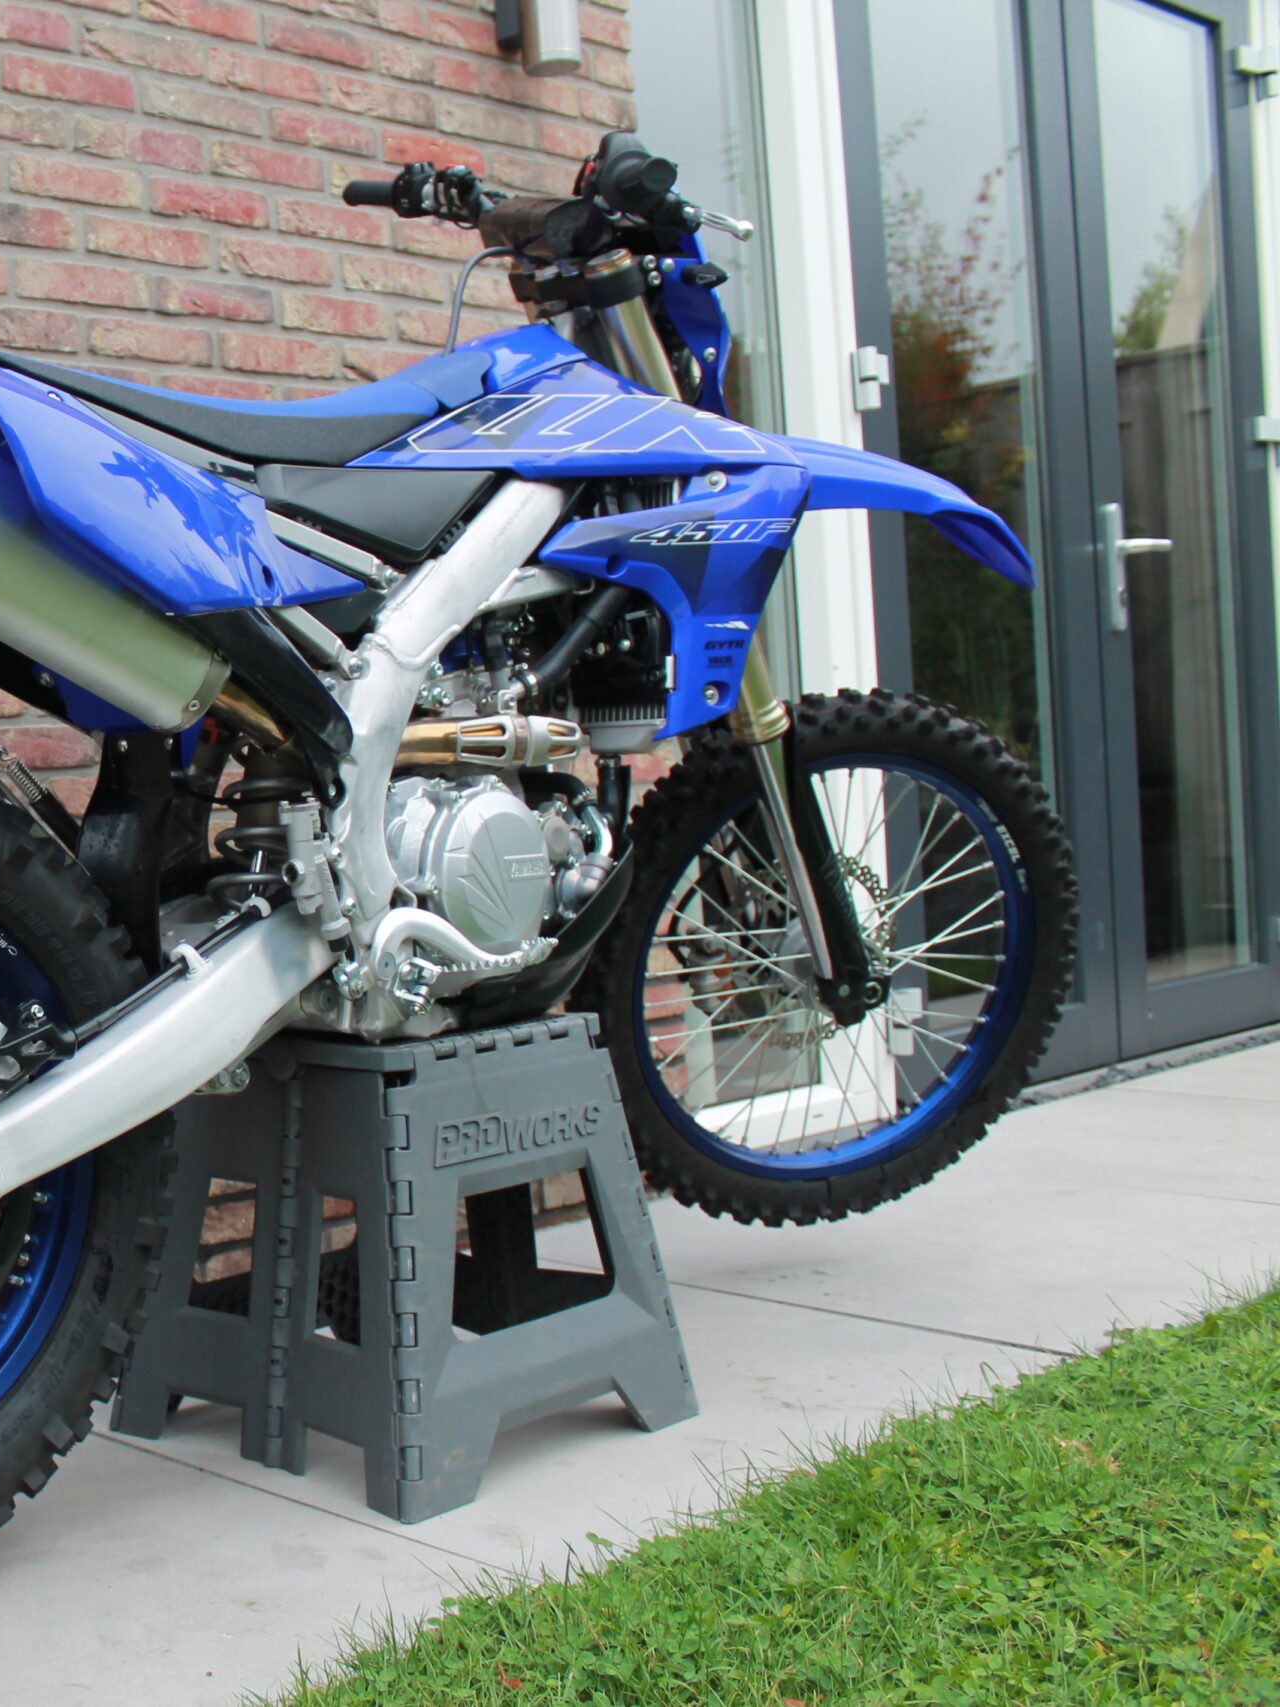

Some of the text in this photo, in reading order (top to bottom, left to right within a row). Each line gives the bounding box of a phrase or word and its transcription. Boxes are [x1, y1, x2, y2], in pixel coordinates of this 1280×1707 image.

[630, 518, 796, 545] 450F
[704, 639, 746, 650] GYTR
[437, 1102, 601, 1164] PROWORKS
